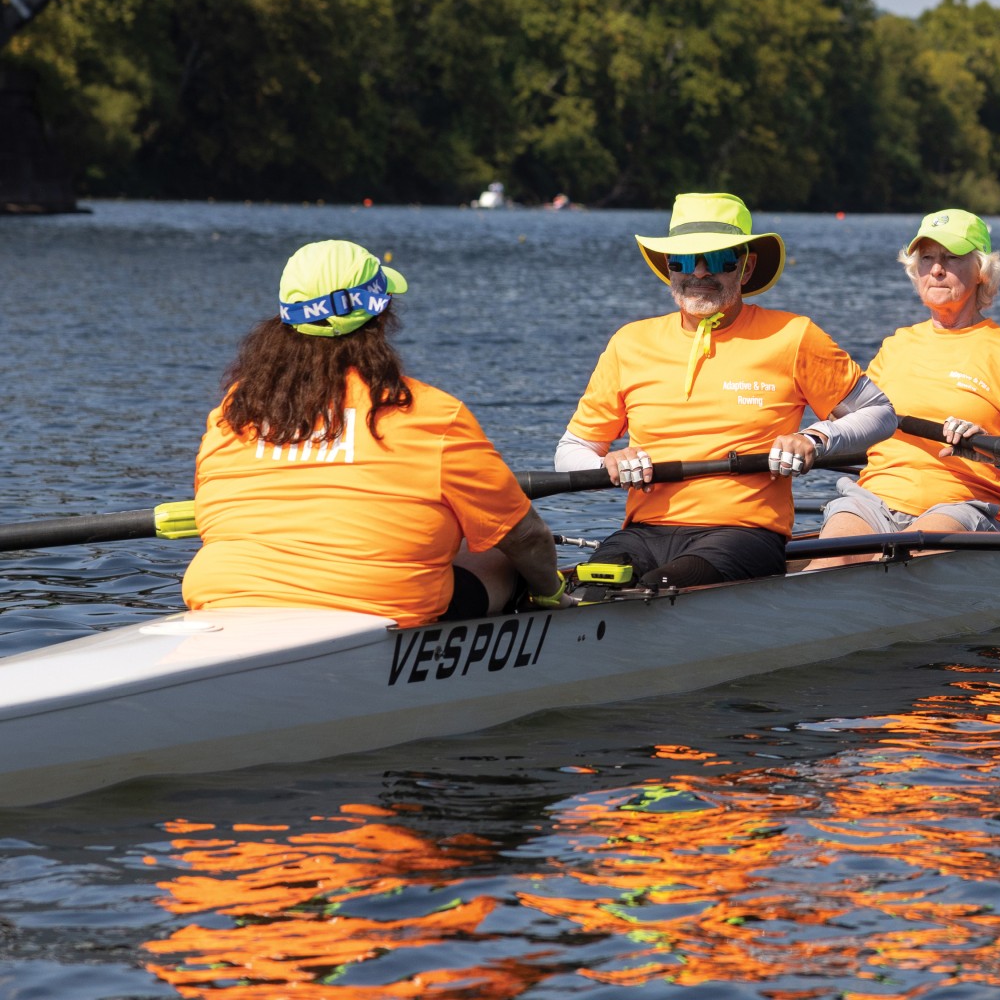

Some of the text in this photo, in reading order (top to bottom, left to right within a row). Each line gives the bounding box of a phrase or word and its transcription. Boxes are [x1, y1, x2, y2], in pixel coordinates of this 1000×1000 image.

[303, 300, 330, 319] NK
[723, 381, 776, 392] Adaptive & Para
[737, 395, 763, 407] Rowing
[388, 614, 552, 686] VESPOLI
